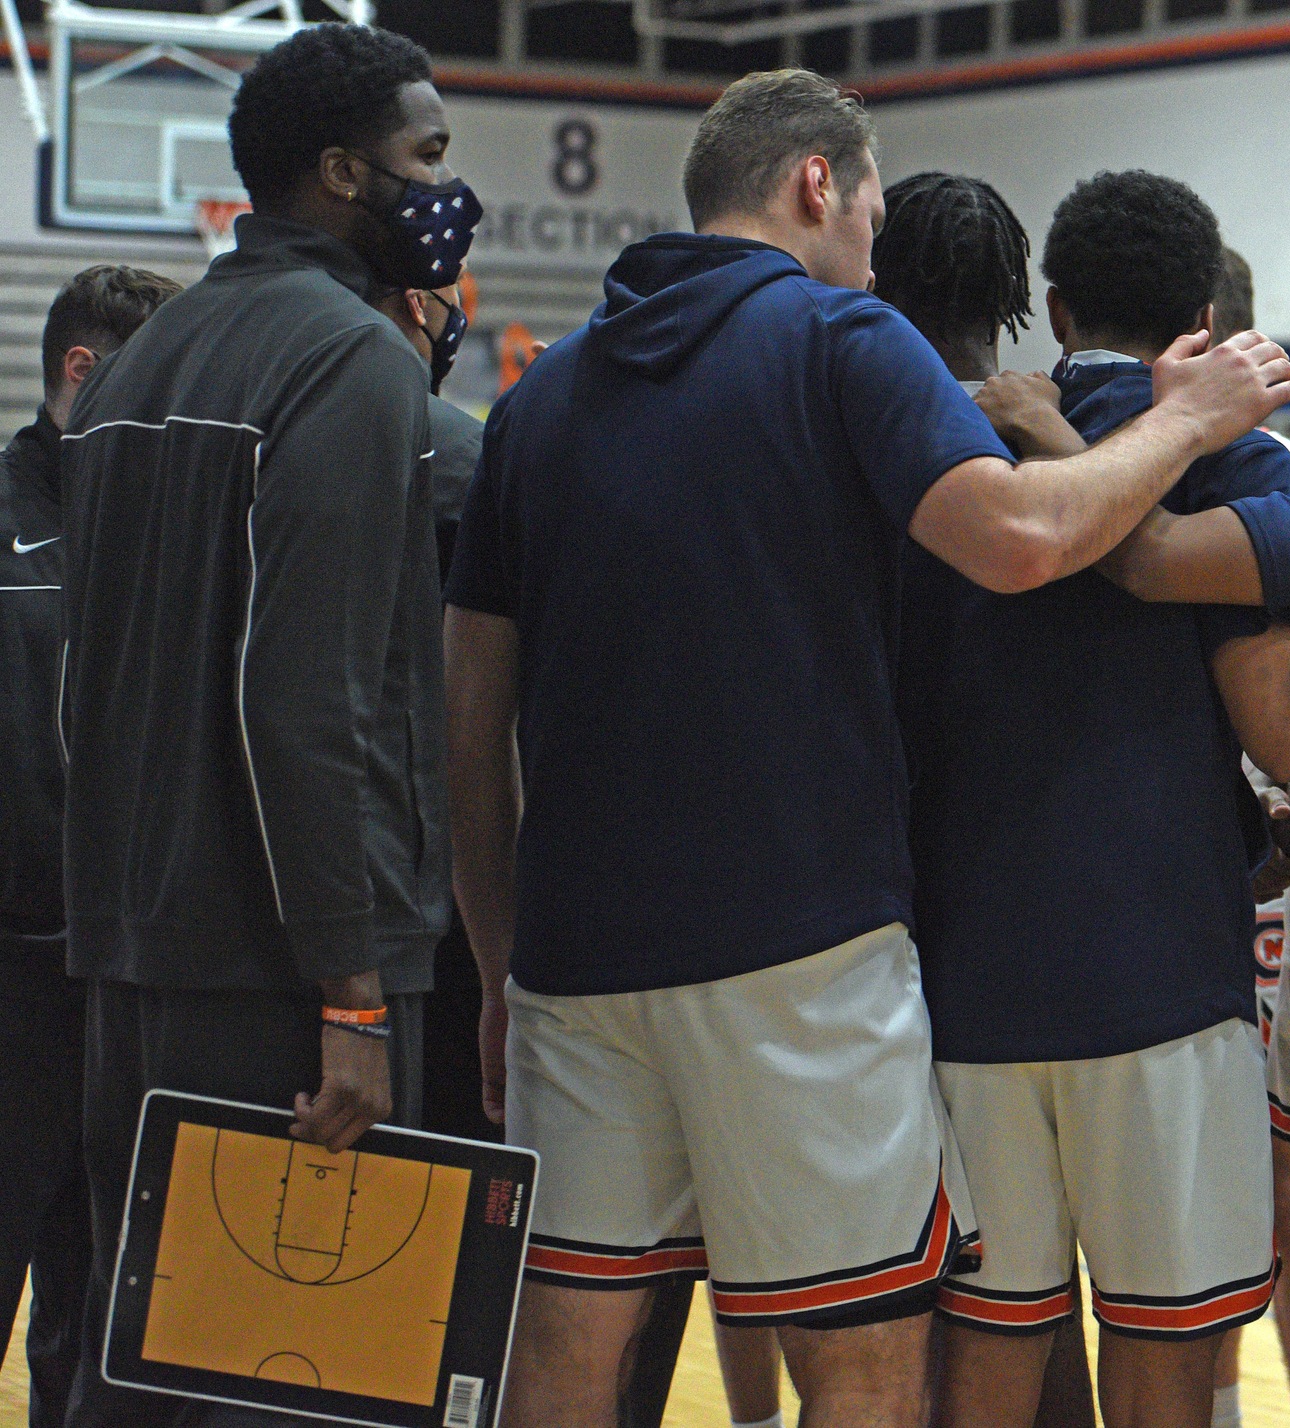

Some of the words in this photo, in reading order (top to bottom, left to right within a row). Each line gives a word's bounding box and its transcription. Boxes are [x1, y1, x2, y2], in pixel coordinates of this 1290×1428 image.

[552, 117, 598, 194] 8
[484, 1178, 500, 1225] HIBBETT
[495, 1180, 513, 1227] SPORTS
